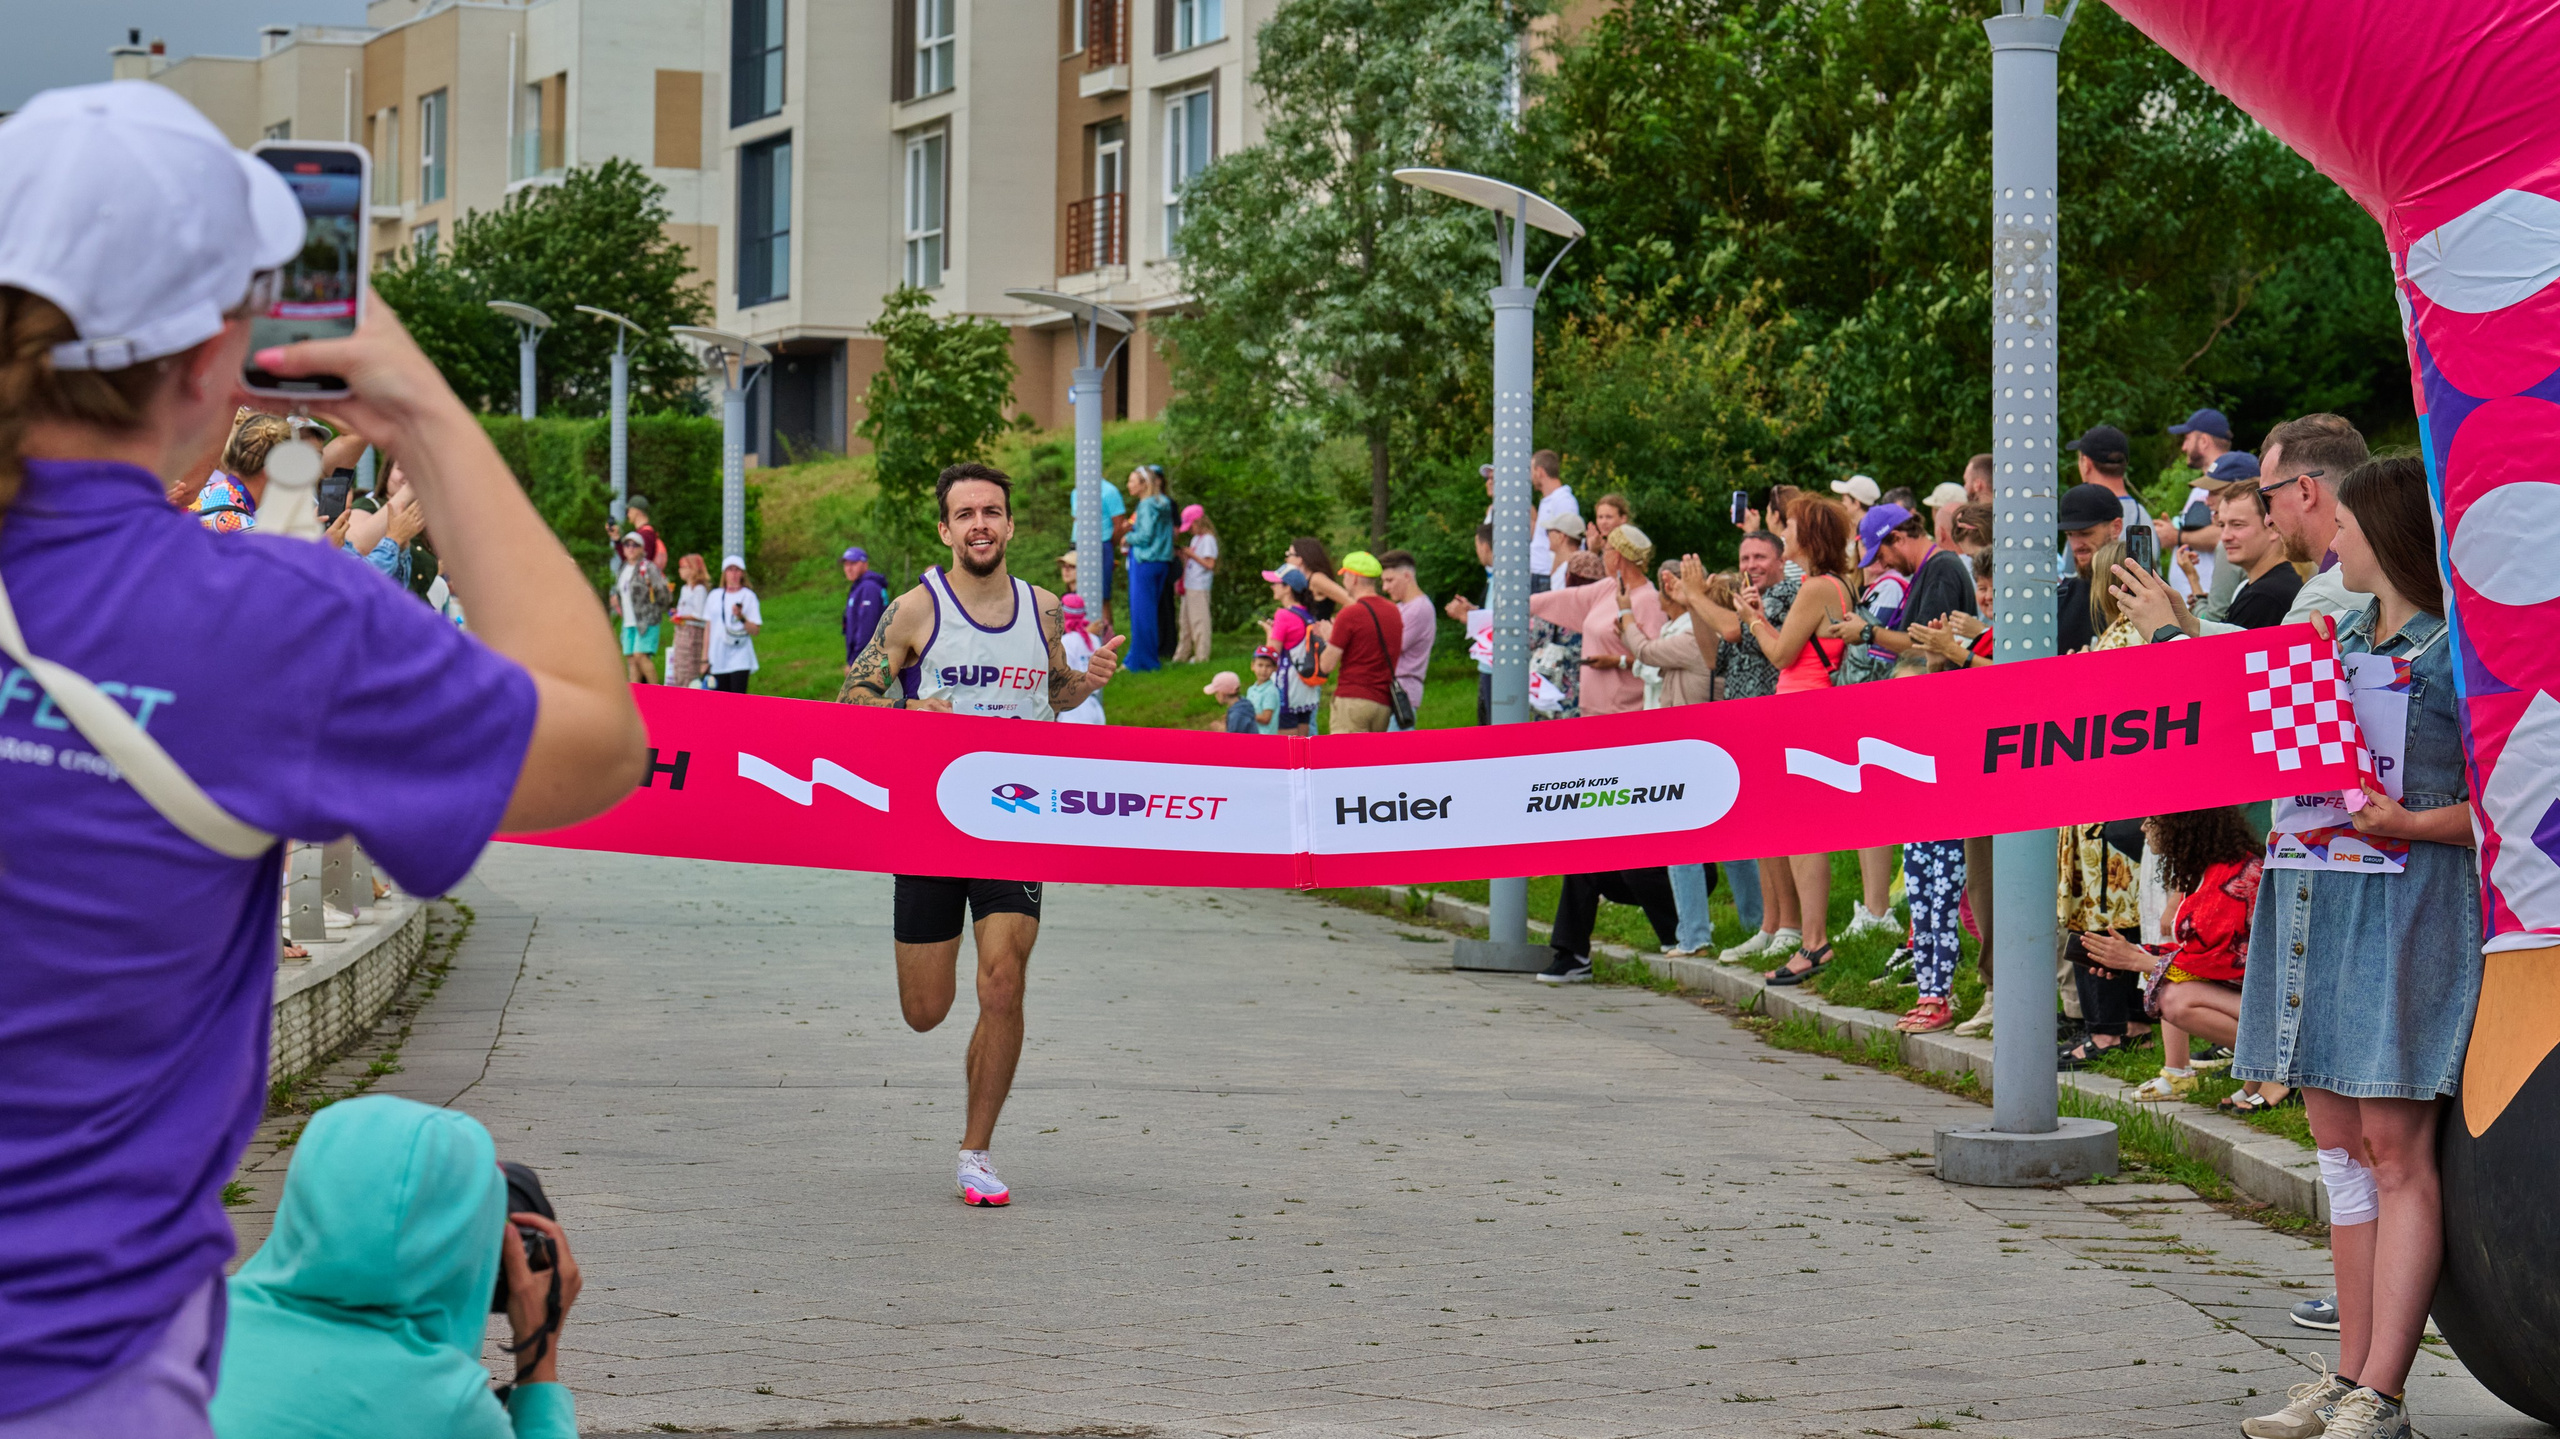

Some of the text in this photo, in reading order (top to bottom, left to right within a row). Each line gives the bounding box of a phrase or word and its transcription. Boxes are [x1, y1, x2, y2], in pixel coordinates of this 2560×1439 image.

[940, 664, 1047, 695] SUPFEST
[1983, 700, 2202, 775] FINISH
[1526, 783, 1685, 813] RUNDNSRUN
[1531, 776, 1619, 792] БЕГОВОЙ КЛУБ
[1060, 789, 1228, 820] SUPFEST
[1336, 792, 1453, 825] Haier
[2333, 852, 2361, 863] DNS
